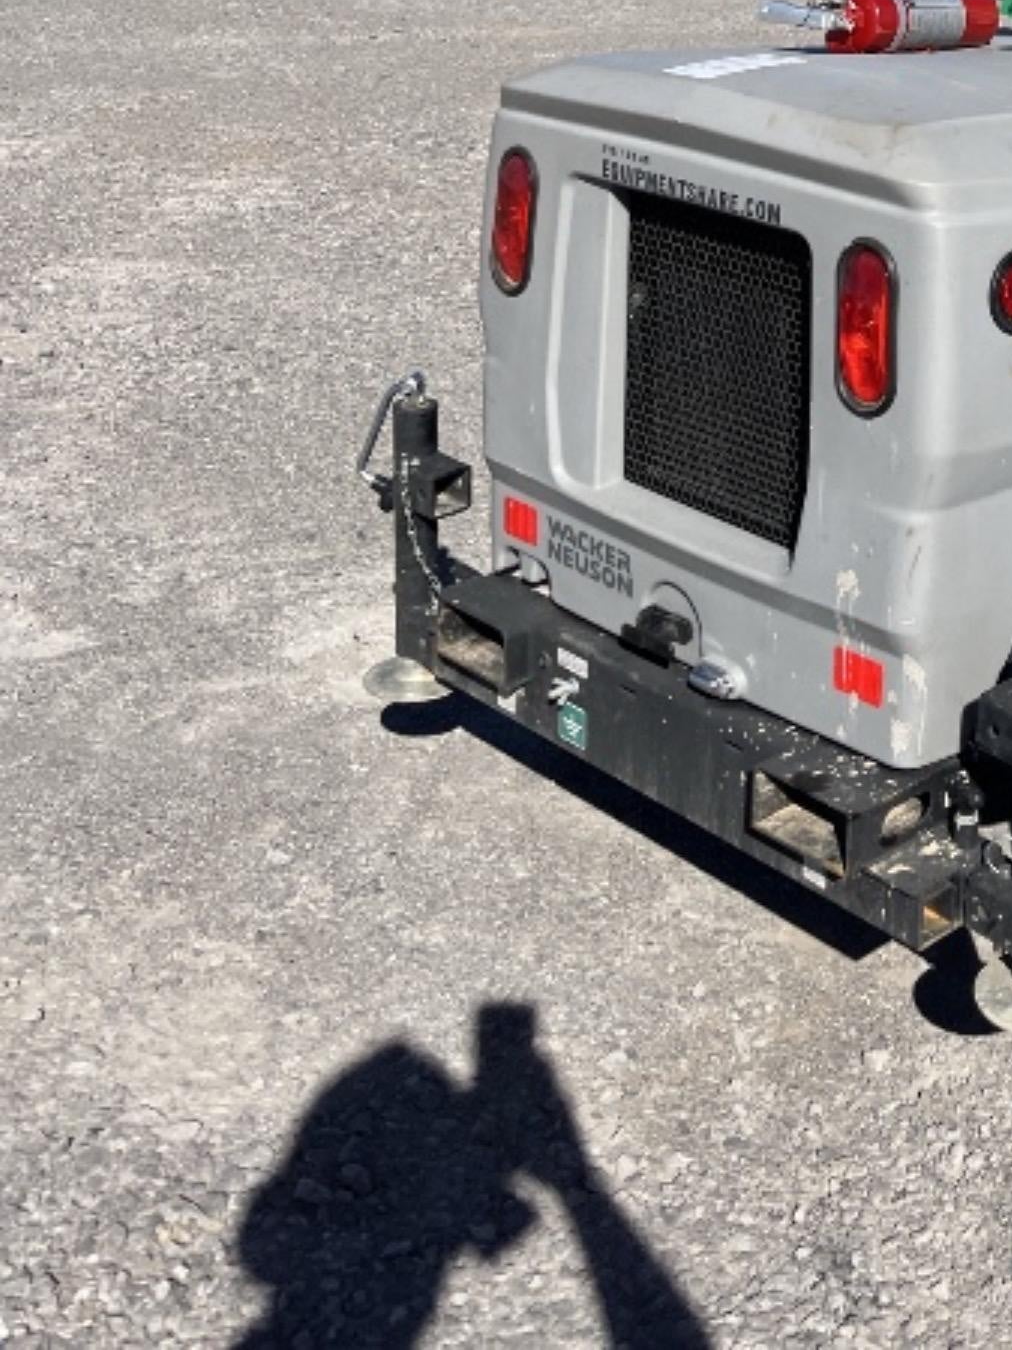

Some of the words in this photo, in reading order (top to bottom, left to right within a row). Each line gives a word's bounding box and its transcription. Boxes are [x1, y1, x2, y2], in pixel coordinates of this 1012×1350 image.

[602, 159, 782, 225] EQUIPMENTSHARE.COM
[546, 514, 630, 574] WACKER
[548, 539, 633, 599] NEUSON
